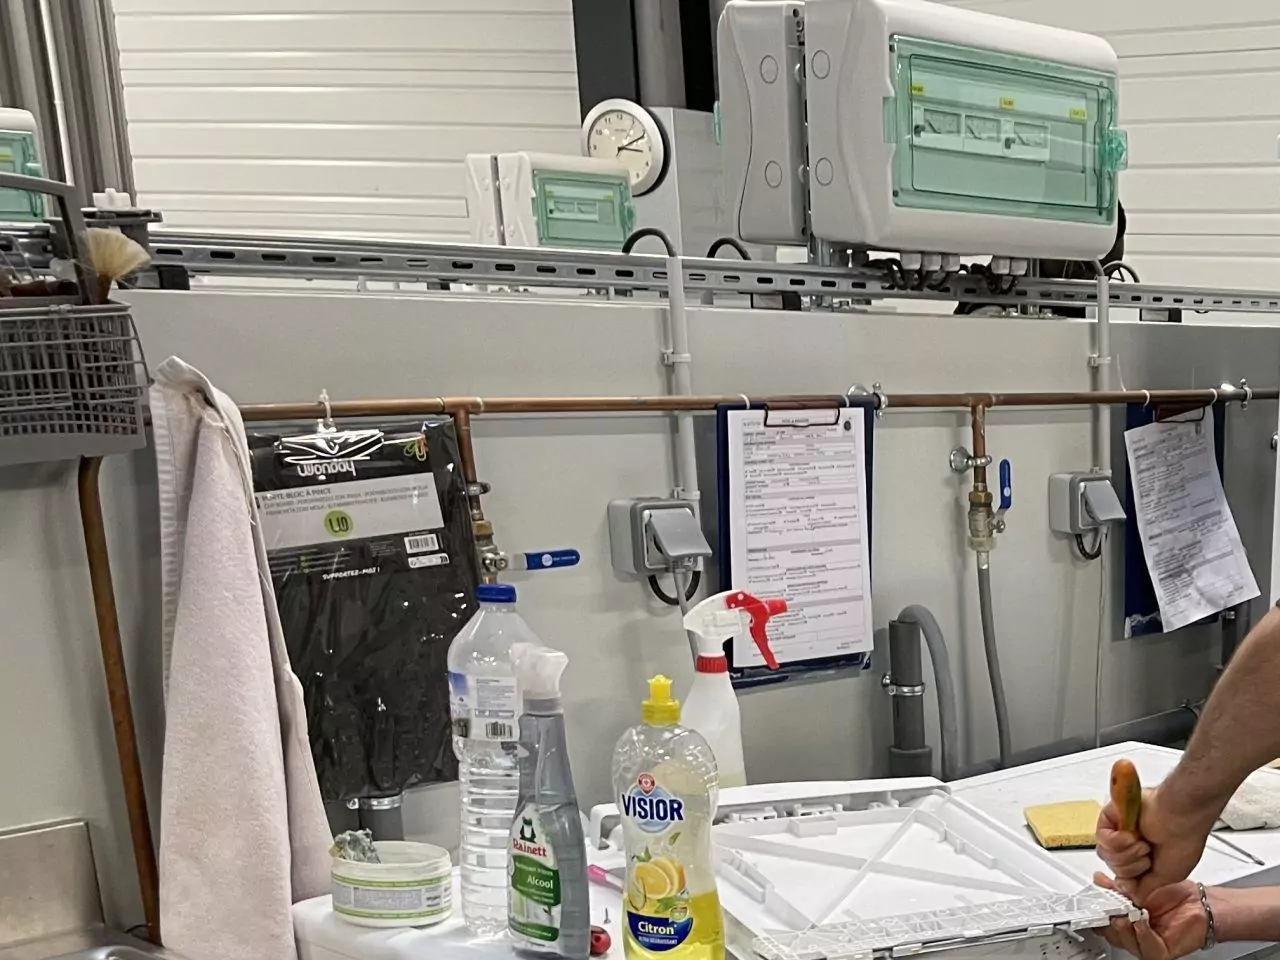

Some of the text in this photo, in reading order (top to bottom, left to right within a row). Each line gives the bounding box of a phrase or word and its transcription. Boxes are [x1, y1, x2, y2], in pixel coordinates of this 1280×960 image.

[621, 793, 684, 821] VISIOR
[512, 838, 548, 857] Rainett
[527, 875, 554, 889] Alcool
[637, 921, 675, 935] Citron
